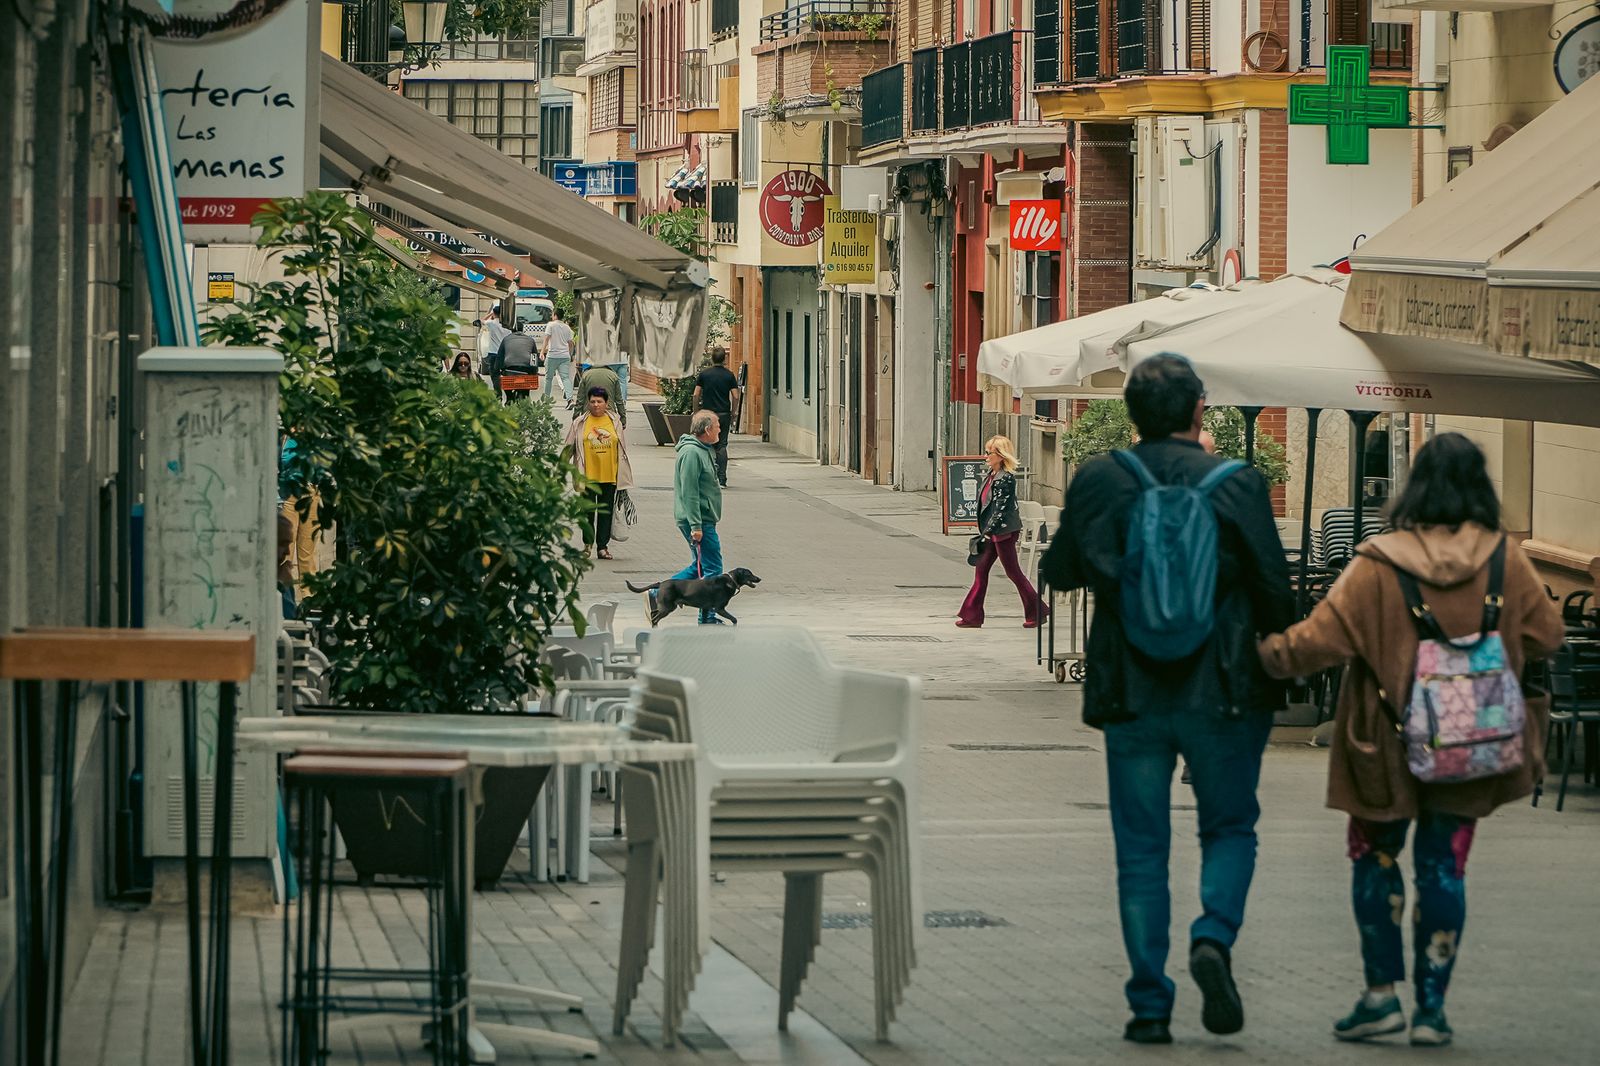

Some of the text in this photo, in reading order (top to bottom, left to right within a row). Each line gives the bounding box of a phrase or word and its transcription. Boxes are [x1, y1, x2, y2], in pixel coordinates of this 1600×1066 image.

[176, 115, 216, 141] Las
[781, 171, 816, 194] 1900
[202, 204, 236, 218] 1982
[826, 208, 874, 224] Trasteros
[768, 224, 824, 245] COMPANY BAR
[844, 227, 856, 239] en
[1013, 206, 1058, 247] illy
[830, 242, 870, 258] Alquiler
[836, 263, 873, 272] 616 90 45 57
[1355, 385, 1433, 399] VICTORIA
